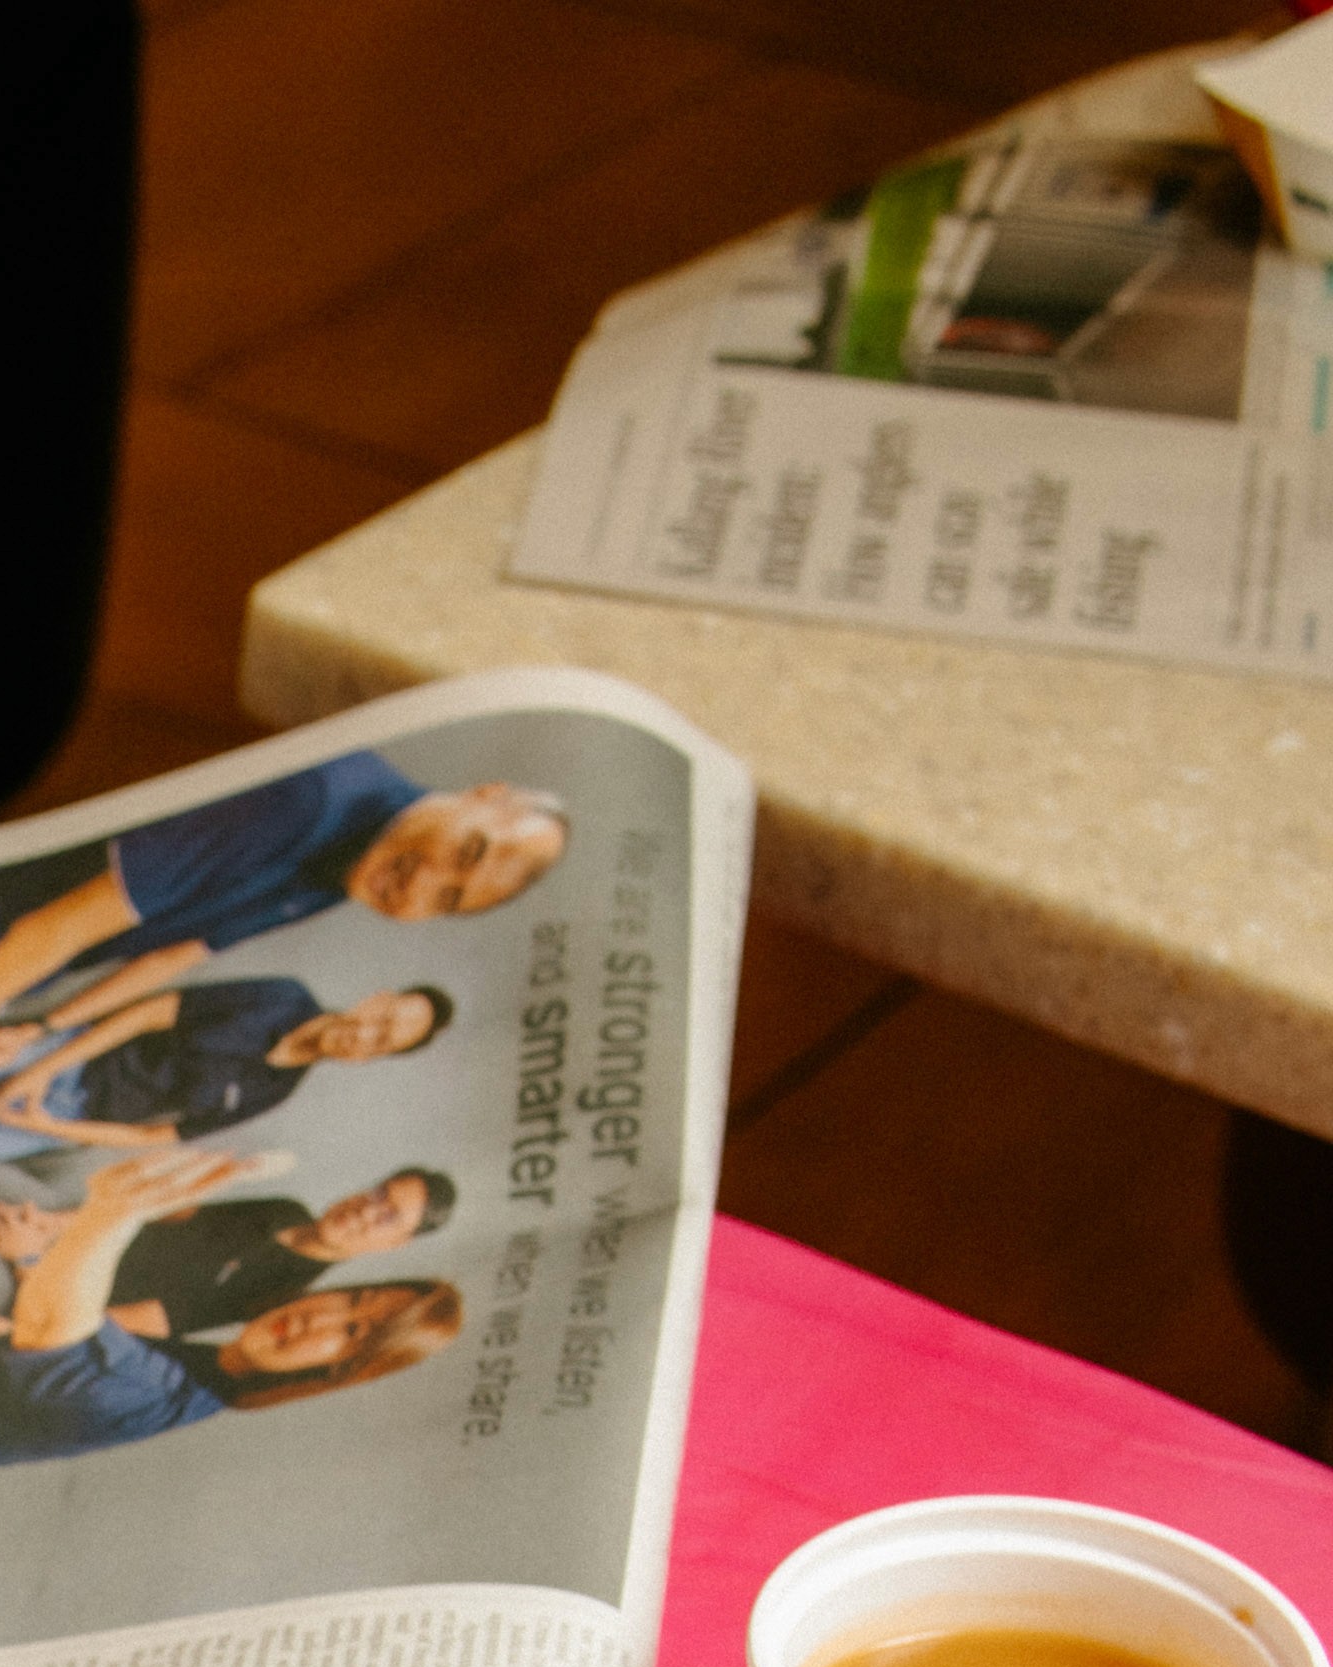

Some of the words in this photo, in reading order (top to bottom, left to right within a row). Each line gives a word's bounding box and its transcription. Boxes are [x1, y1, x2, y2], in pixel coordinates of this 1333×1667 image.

[530, 923, 569, 987] and
[509, 1001, 570, 1205] smarter
[576, 952, 659, 1167] stronger
[496, 1228, 544, 1298] when
[582, 1183, 631, 1270] when
[482, 1307, 521, 1348] we
[569, 1277, 610, 1318] we
[461, 1356, 520, 1446] share.
[541, 1324, 614, 1416] listen,
